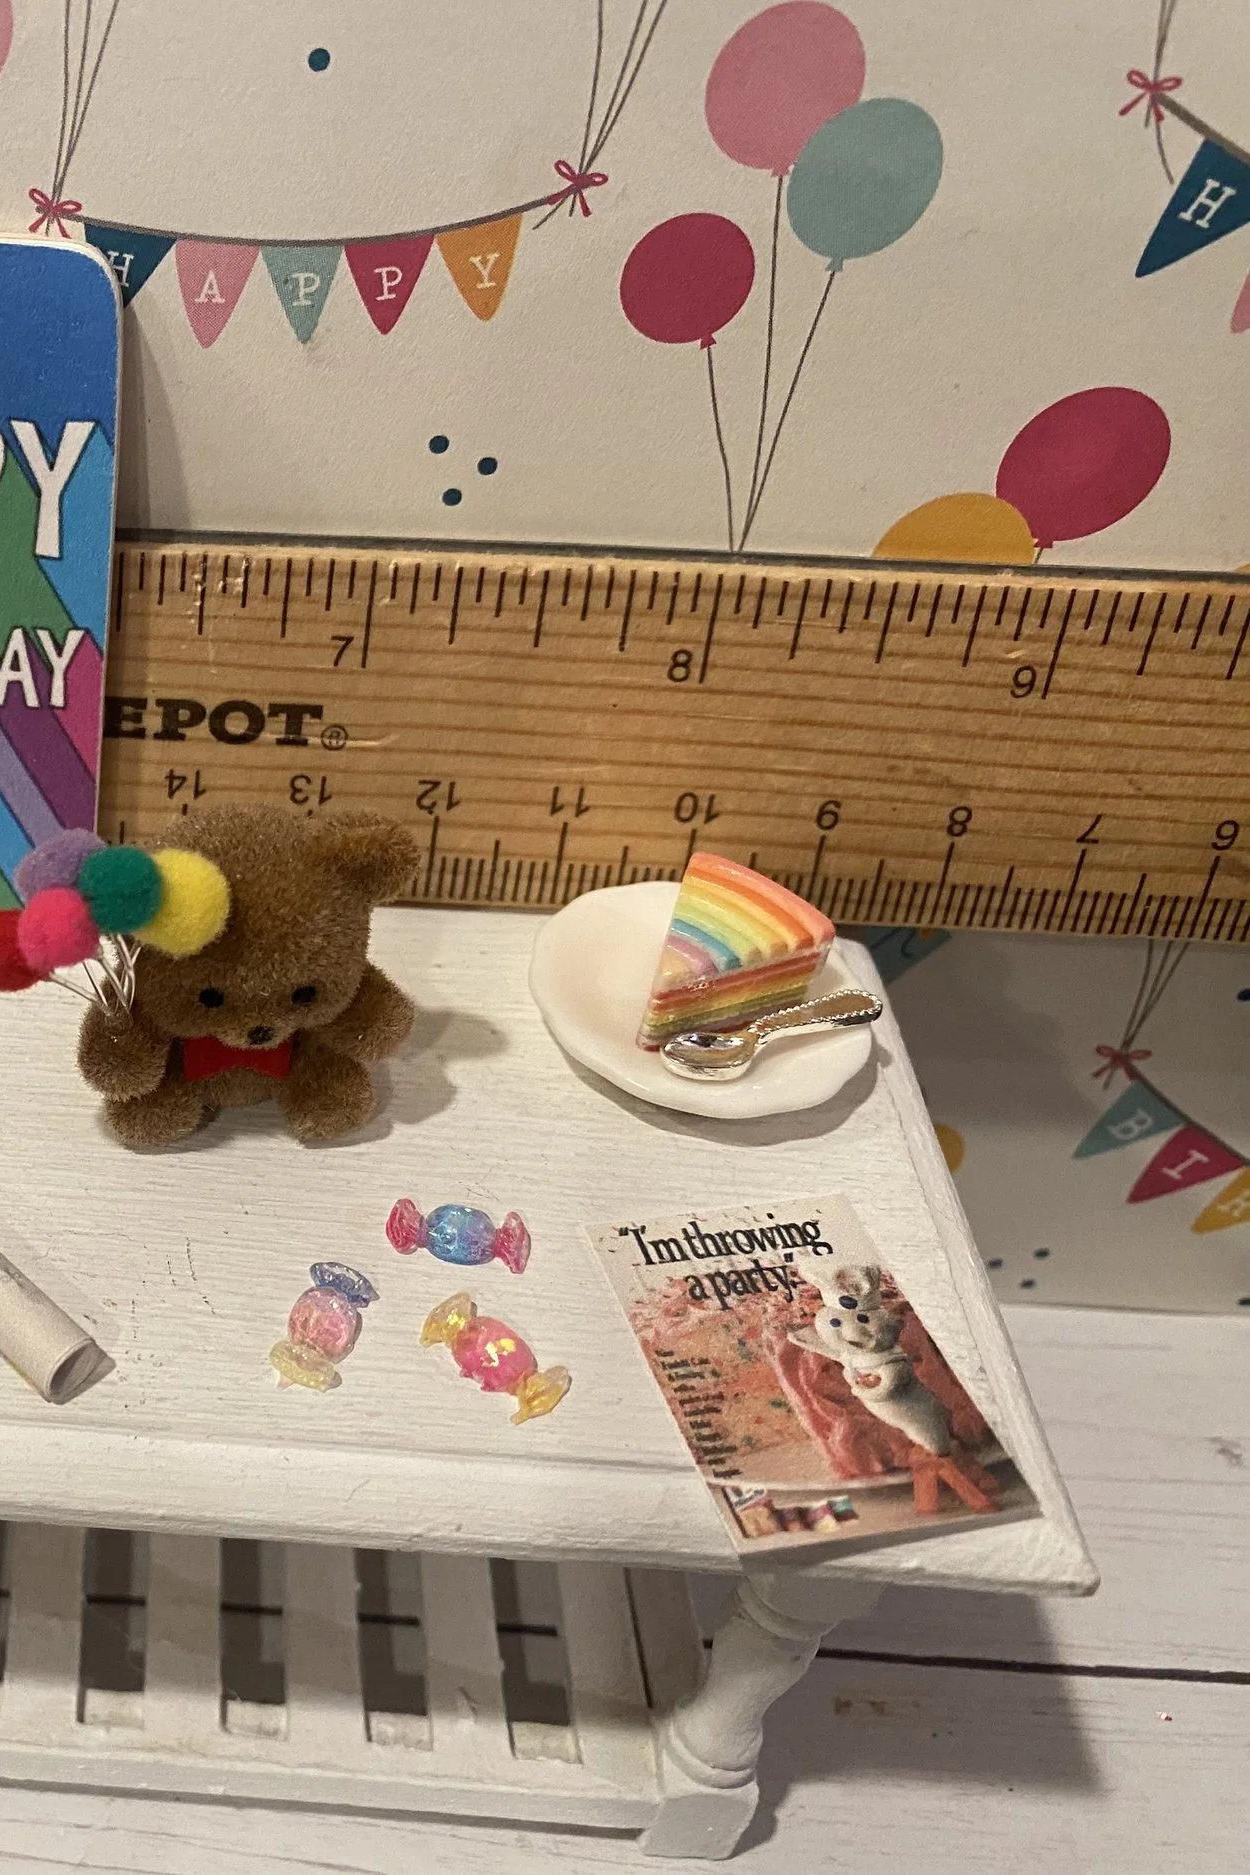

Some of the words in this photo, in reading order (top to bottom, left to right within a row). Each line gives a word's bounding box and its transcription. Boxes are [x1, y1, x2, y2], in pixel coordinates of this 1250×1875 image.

[107, 250, 501, 307] HAPPY
[330, 635, 354, 667] 7
[667, 650, 692, 682] 8
[1010, 665, 1037, 698] 9
[165, 769, 207, 799] 14
[290, 774, 333, 805] 13
[415, 779, 461, 812] 12
[551, 785, 591, 818] 11
[674, 793, 720, 825] 10
[948, 807, 973, 837] 8
[1076, 814, 1102, 844] 7
[682, 1213, 834, 1259] throwing
[684, 1275, 710, 1301] a
